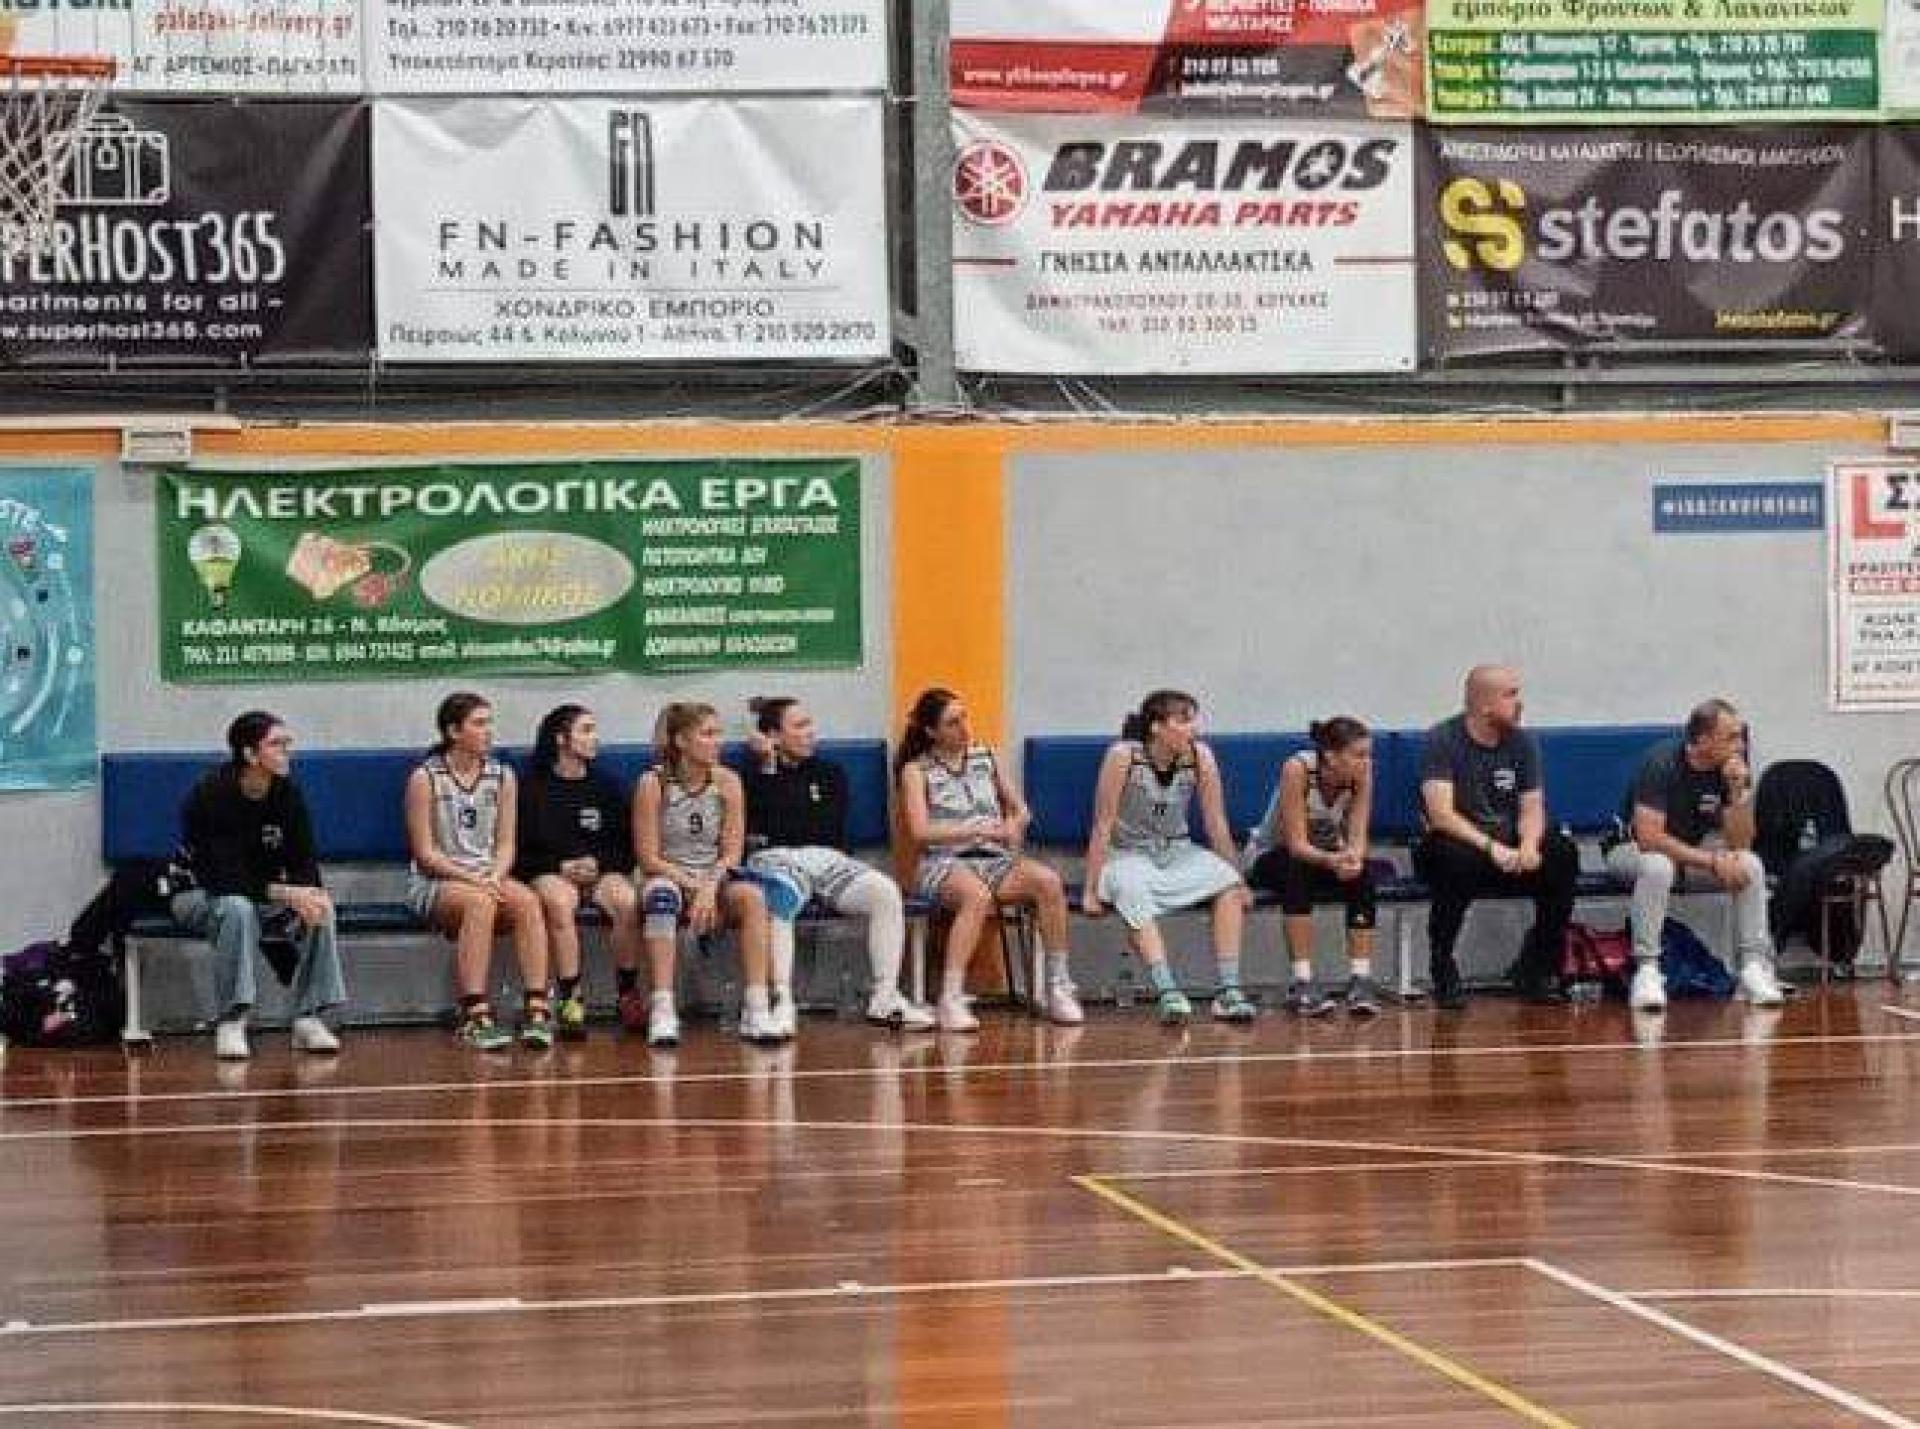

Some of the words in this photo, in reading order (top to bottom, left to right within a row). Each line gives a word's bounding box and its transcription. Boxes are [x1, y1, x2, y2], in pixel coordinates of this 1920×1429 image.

[1043, 138, 1397, 192] BRAMOS
[1049, 201, 1222, 228] YAMAHA
[1233, 201, 1361, 227] PARTS
[1537, 190, 1845, 263] stefatos
[438, 220, 823, 252] FN-FASHION
[438, 259, 570, 281] MADE
[609, 259, 651, 280] IN
[690, 259, 826, 281] ITALY
[1039, 249, 1129, 274] ΓΝΗΣΙΑ
[1139, 248, 1314, 274] ΑΝΤΑΛΛΑΚΤΙΚΑ
[0, 289, 147, 312] artments
[162, 289, 204, 311] for
[217, 289, 258, 311] all
[494, 299, 635, 321] ΧΟΝΔΡΙΚΟ
[649, 299, 774, 320] ΕΜΠΟΡΙΟ
[177, 478, 681, 519] ΗΛΕΚΤΡΟΛΟΓΙΚΑ
[701, 477, 839, 509] ΕΡΓΑ
[463, 809, 477, 828] 3
[689, 813, 703, 834] 9
